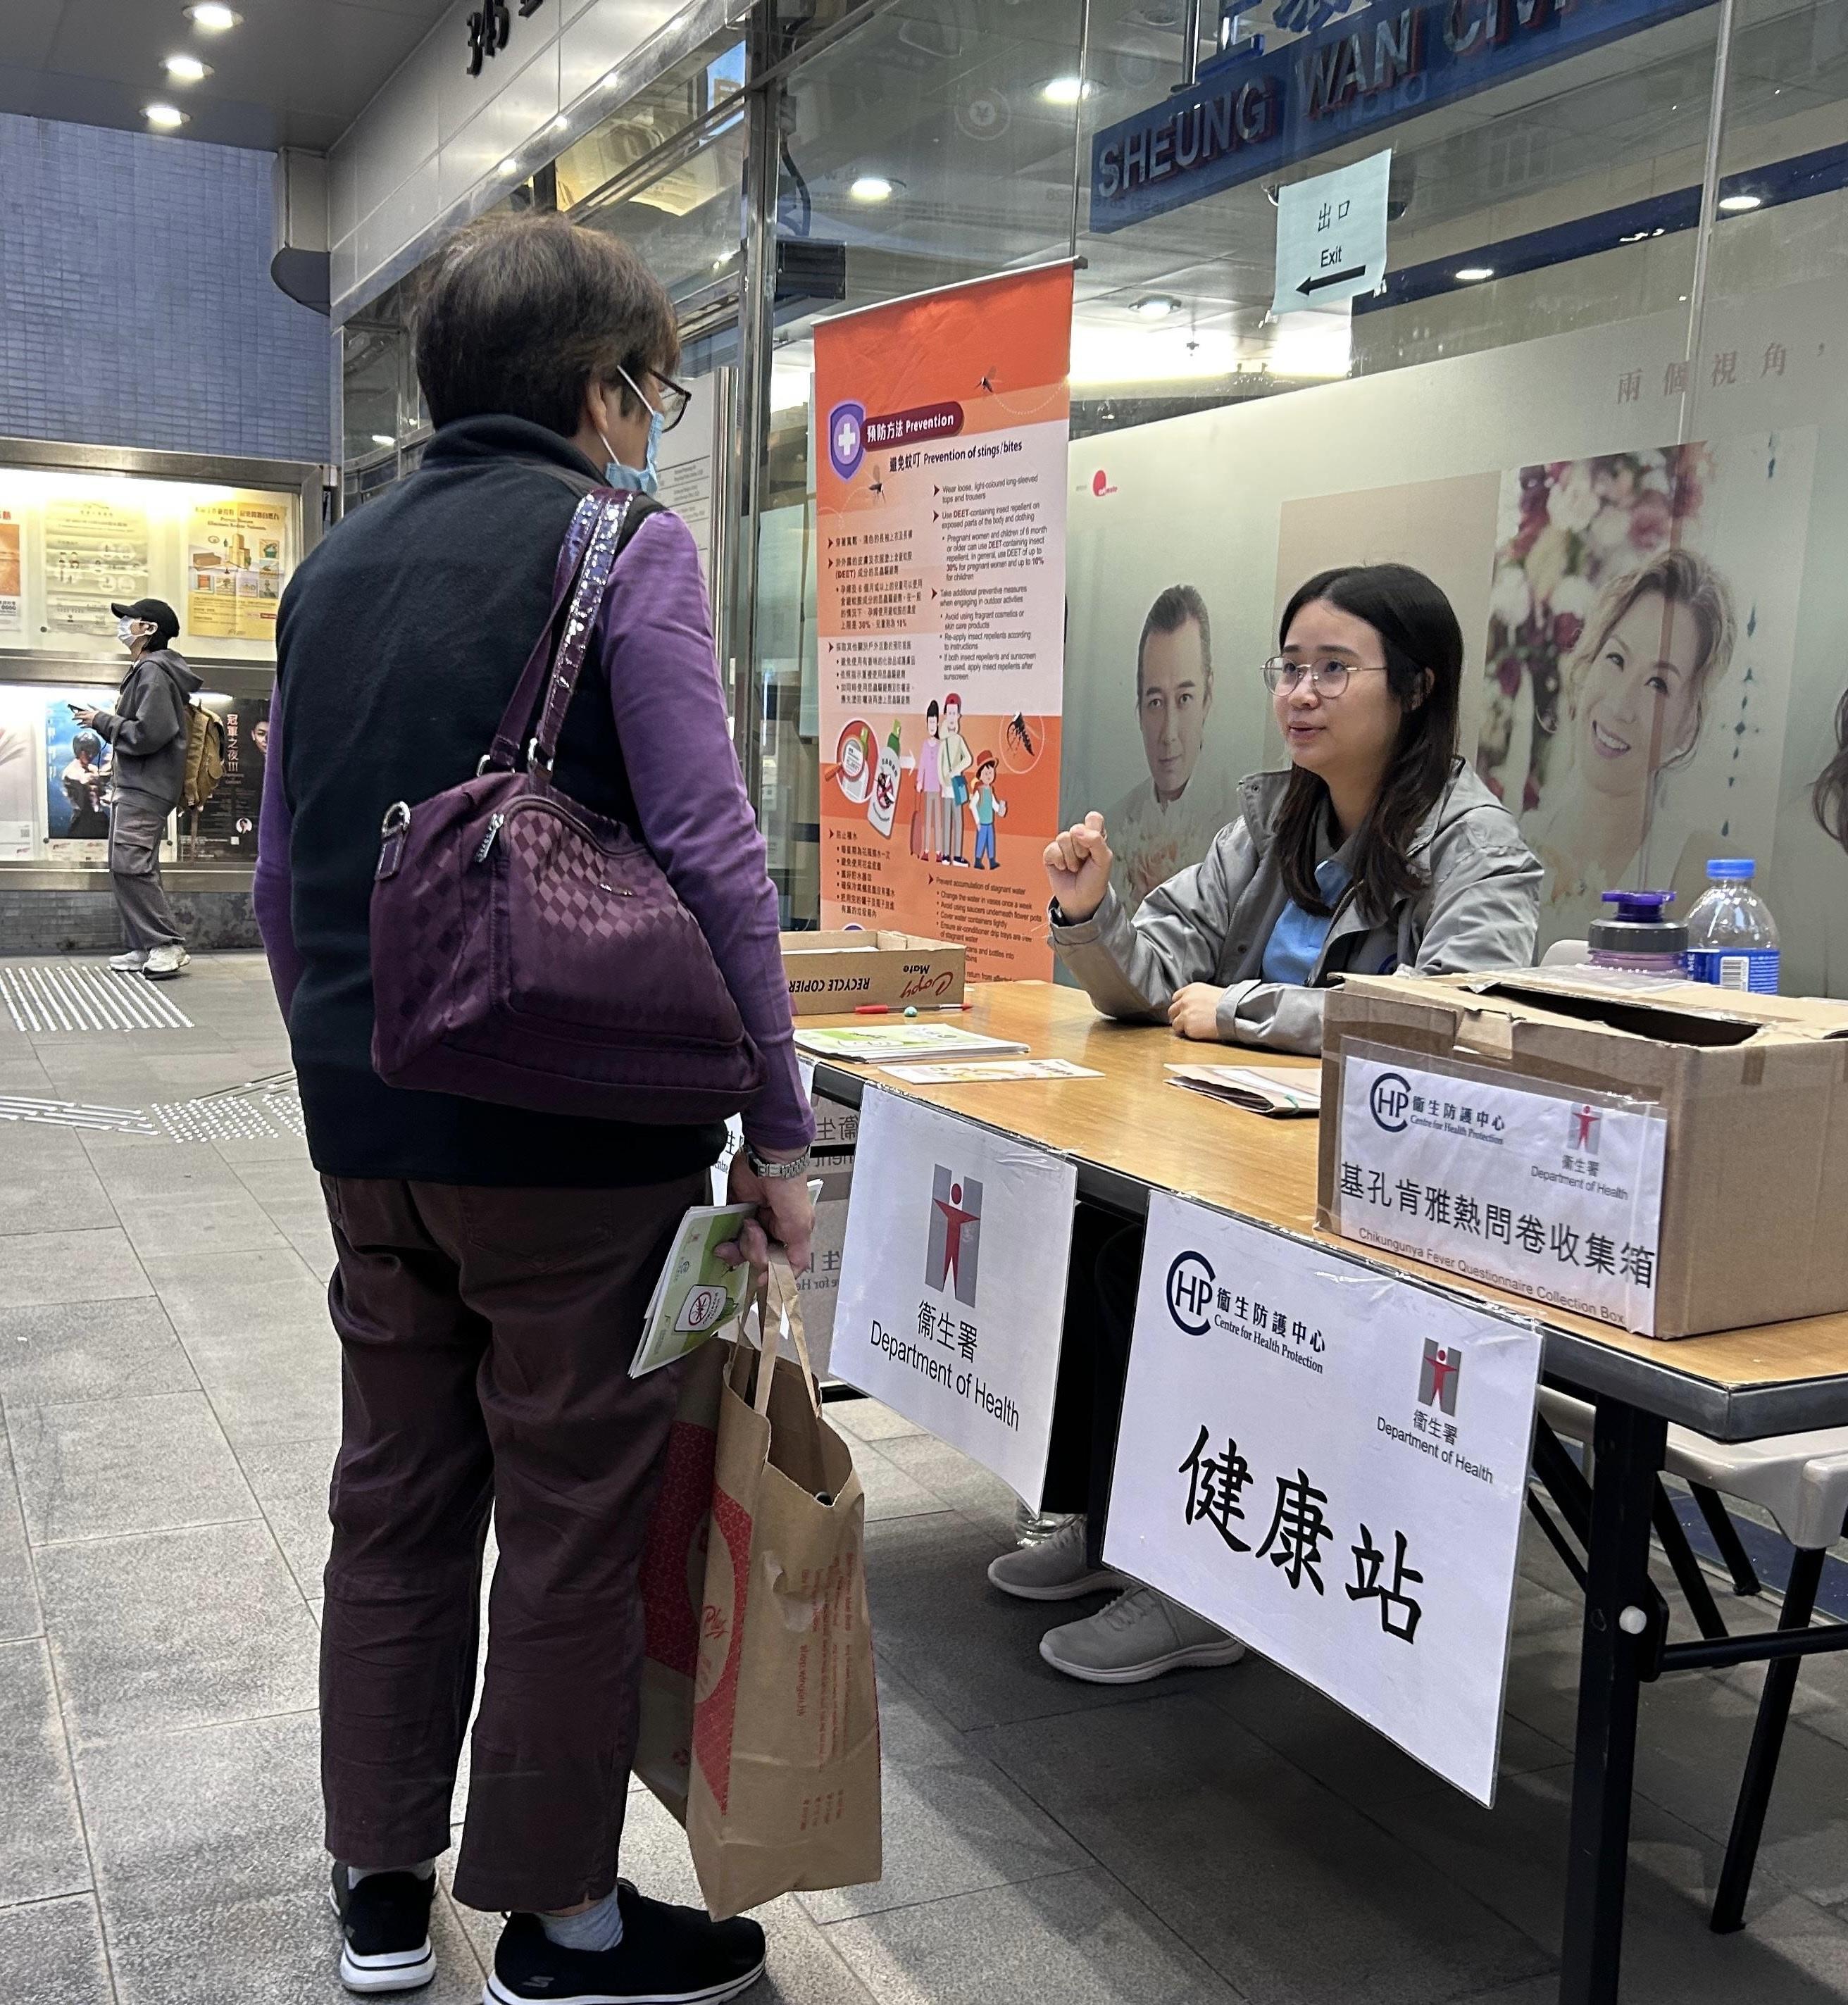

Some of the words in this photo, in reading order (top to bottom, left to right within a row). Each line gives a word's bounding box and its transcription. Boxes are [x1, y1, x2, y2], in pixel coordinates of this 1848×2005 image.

[1099, 79, 1266, 197] SHEUNG
[1294, 8, 1411, 115] WAN
[1318, 200, 1350, 232] 出口
[1321, 245, 1342, 268] Exit
[867, 420, 904, 442] 預防方法
[906, 413, 954, 434] Prevention
[889, 451, 920, 473] 避免蚊叮
[924, 449, 966, 465] Prevention
[968, 445, 975, 458] of
[978, 440, 1023, 458] stings/bites
[942, 495, 953, 504] tops
[954, 494, 964, 502] and
[966, 492, 986, 501] trousers
[996, 504, 1009, 513] insect
[1010, 502, 1032, 512] repellent
[942, 520, 963, 530] exposed
[964, 519, 977, 528] parts
[993, 516, 1004, 526] body
[1005, 515, 1014, 523] and
[1015, 513, 1035, 523] clothing
[836, 569, 856, 579] (DEET)
[954, 573, 974, 581] children
[828, 977, 870, 992] RECYCLE
[899, 971, 954, 999] Copy
[903, 965, 930, 974] Mate
[789, 978, 825, 993] COPIER
[1370, 1073, 1411, 1132] CHP
[1410, 1114, 1432, 1128] Centre
[1432, 1120, 1444, 1130] for
[1444, 1123, 1467, 1137] Health
[1468, 1128, 1504, 1145] Protection
[1531, 1166, 1584, 1189] Department
[1586, 1180, 1596, 1191] of
[1597, 1183, 1628, 1201] Health
[1340, 1161, 1655, 1289] 基孔肯雅熱問卷收集箱
[1359, 1227, 1424, 1259] Chikungunya
[1427, 1249, 1455, 1267] Fever
[1459, 1259, 1533, 1296] Questionnaire
[1537, 1286, 1597, 1316] Collection
[1600, 1306, 1625, 1324] Box
[1166, 1251, 1216, 1336] CHP
[1214, 1314, 1240, 1335] Centre
[1241, 1325, 1252, 1341] for
[1254, 1330, 1280, 1354] Health
[1281, 1344, 1323, 1374] Protection
[870, 1319, 952, 1389] Department
[956, 1373, 972, 1398] of
[975, 1378, 1019, 1432] Health
[1377, 1416, 1439, 1459] Department
[1441, 1450, 1454, 1465] of
[1455, 1453, 1494, 1484] Health
[1178, 1424, 1424, 1644] 健康站
